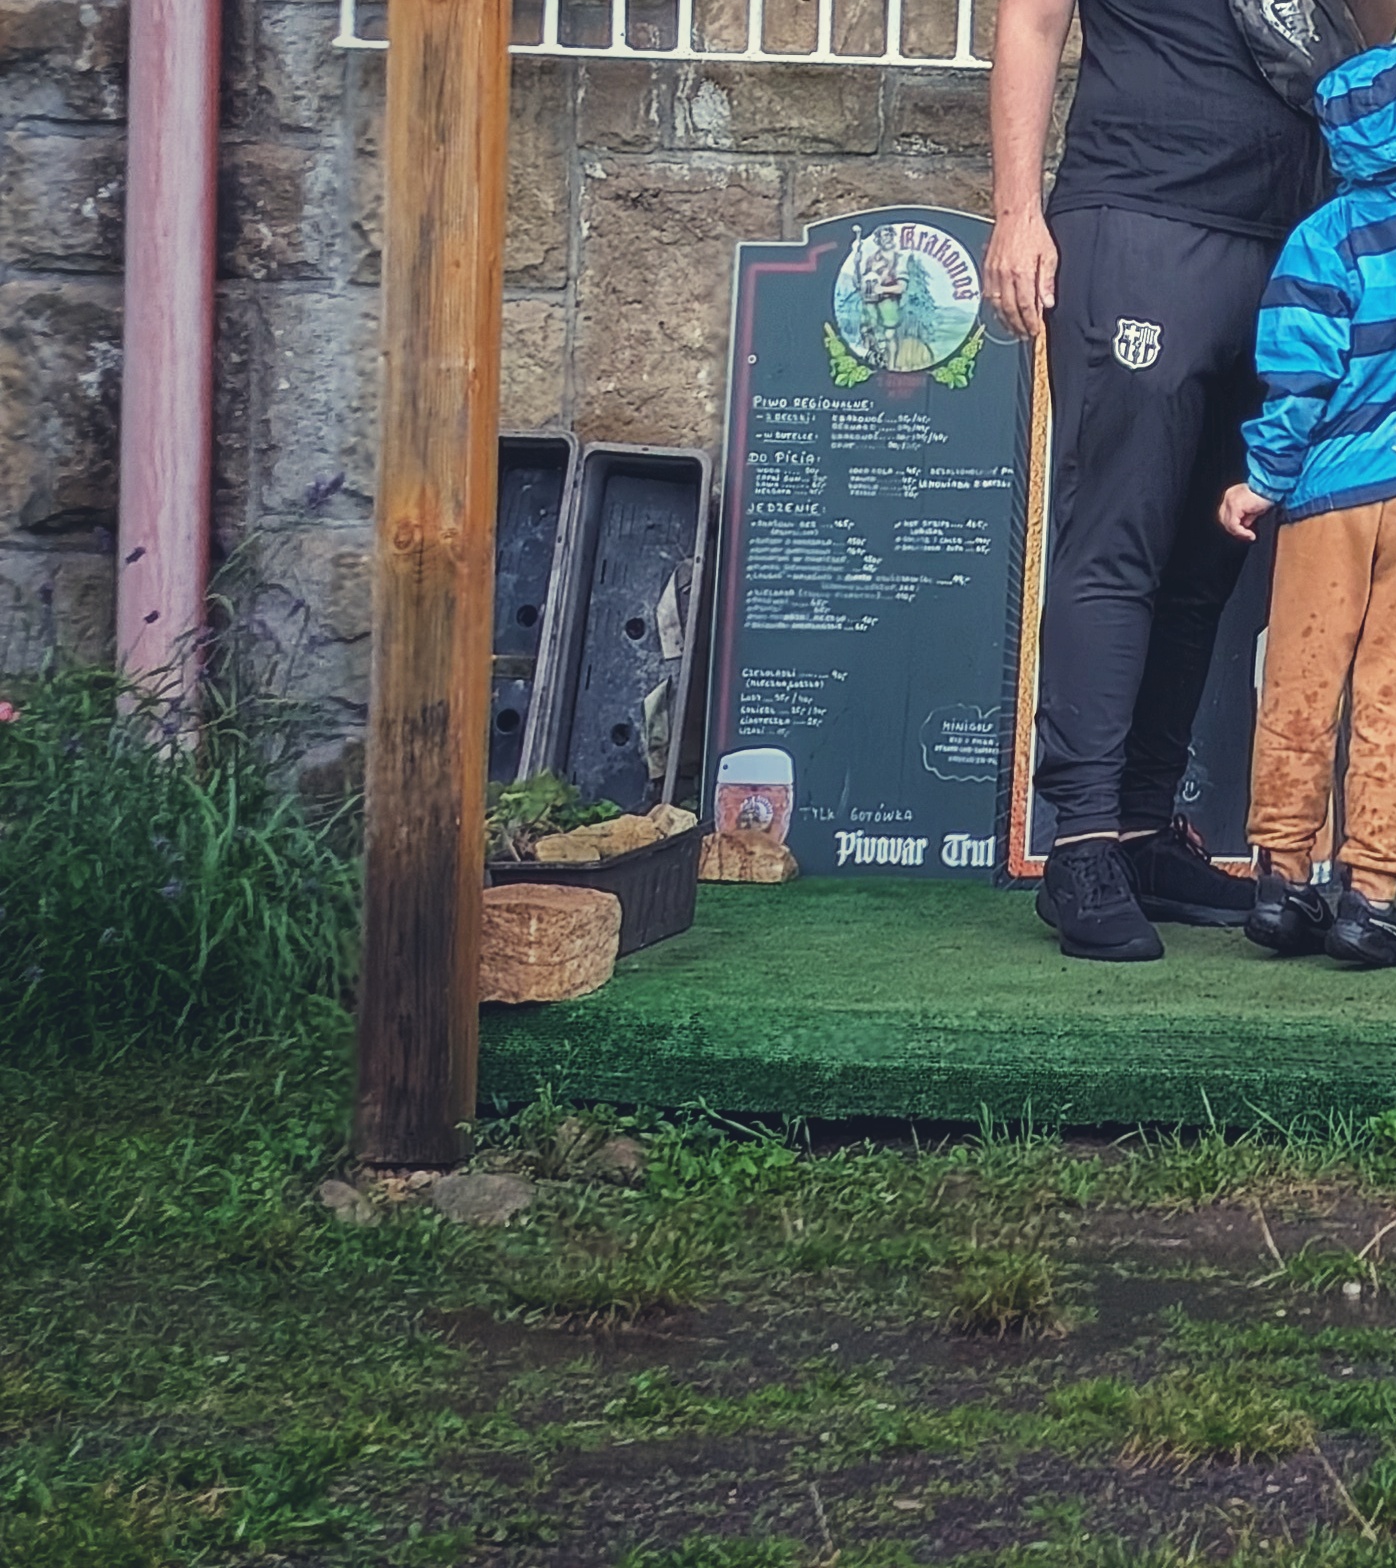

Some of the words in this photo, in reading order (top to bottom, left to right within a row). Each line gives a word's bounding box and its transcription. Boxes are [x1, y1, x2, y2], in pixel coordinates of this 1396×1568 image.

[900, 225, 979, 300] Krakonoš
[753, 395, 787, 408] PIWO
[748, 452, 767, 463] DO
[835, 830, 929, 867] Pivovar
[941, 834, 997, 868] Trut
